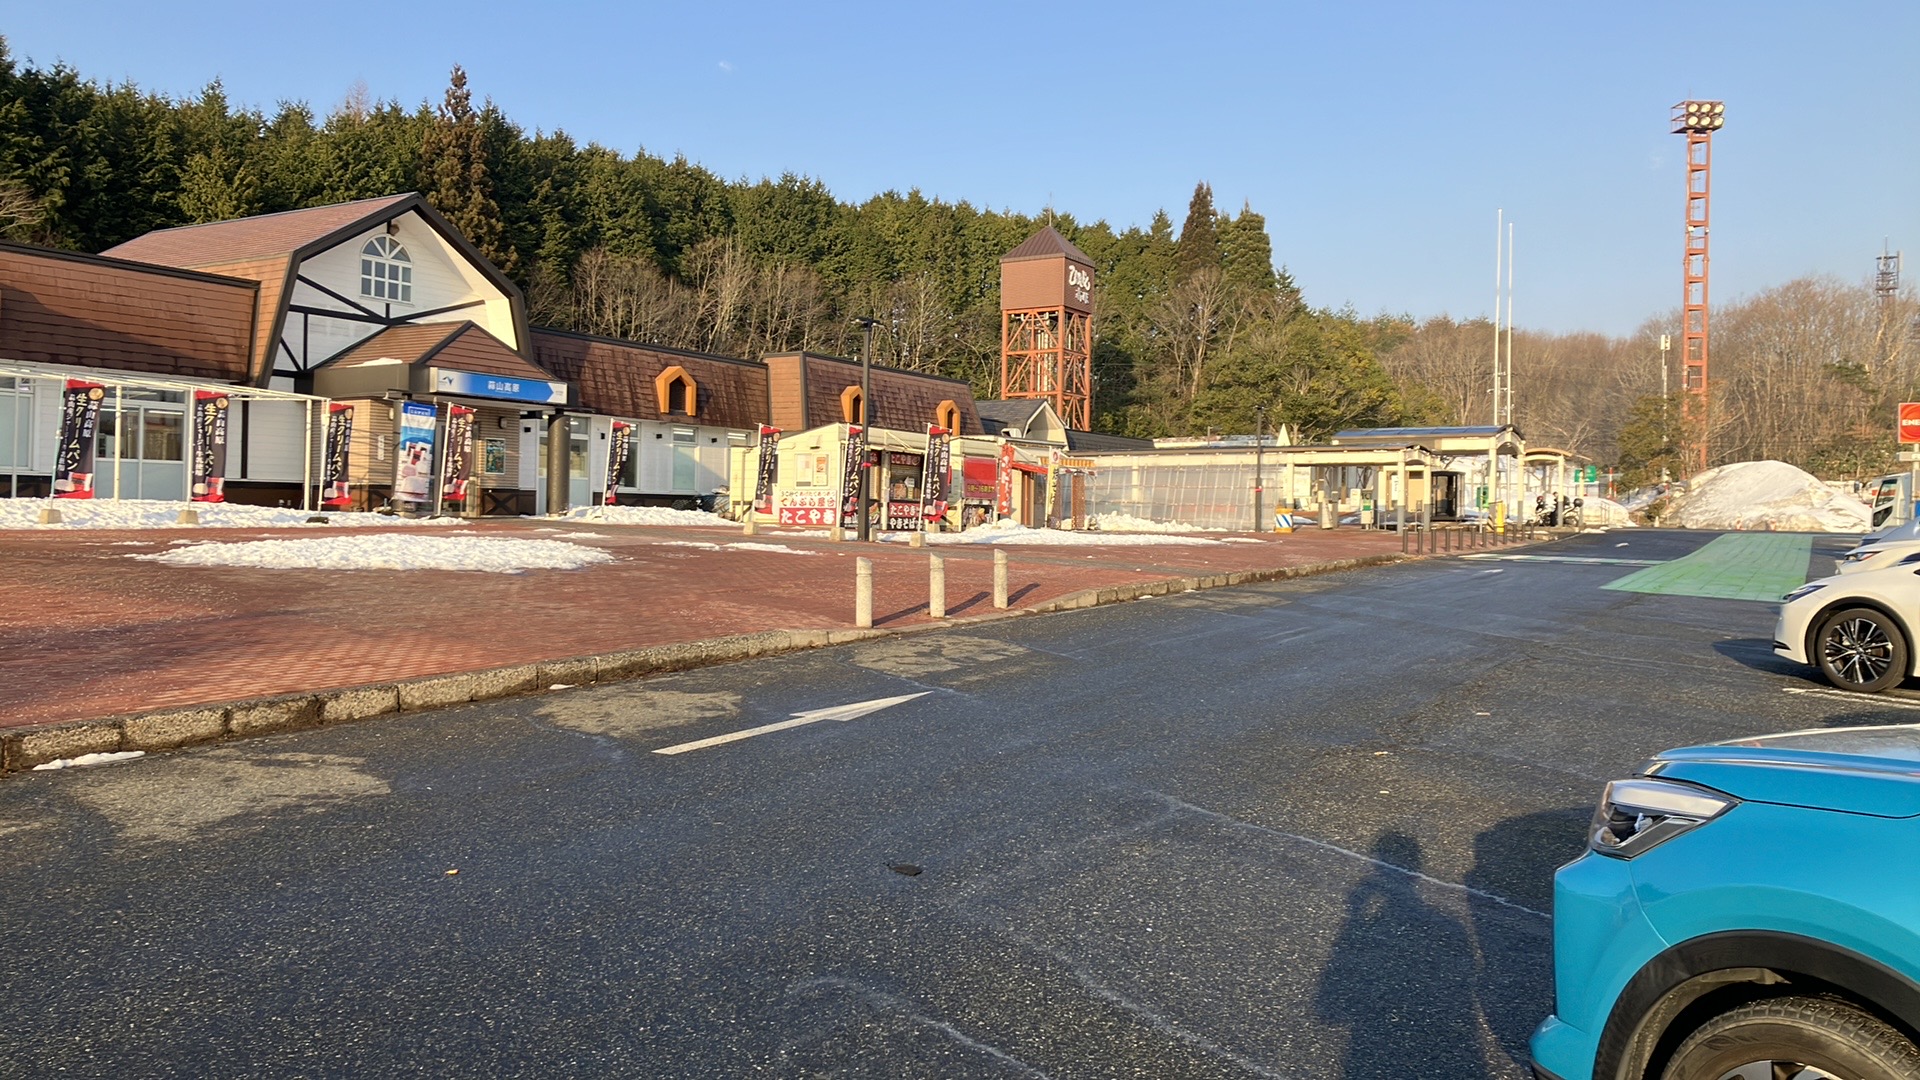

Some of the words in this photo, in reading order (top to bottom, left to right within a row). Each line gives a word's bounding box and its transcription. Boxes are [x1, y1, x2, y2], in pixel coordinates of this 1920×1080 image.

[66, 393, 87, 470] 生クリームパン
[204, 403, 217, 475] 生クリームパン
[331, 414, 346, 480] 生クリームパン
[452, 417, 466, 477] 生クリームパン
[849, 437, 861, 496] 生クリームパン
[932, 437, 941, 499] 生クリームパン
[780, 509, 835, 524] たこやき
